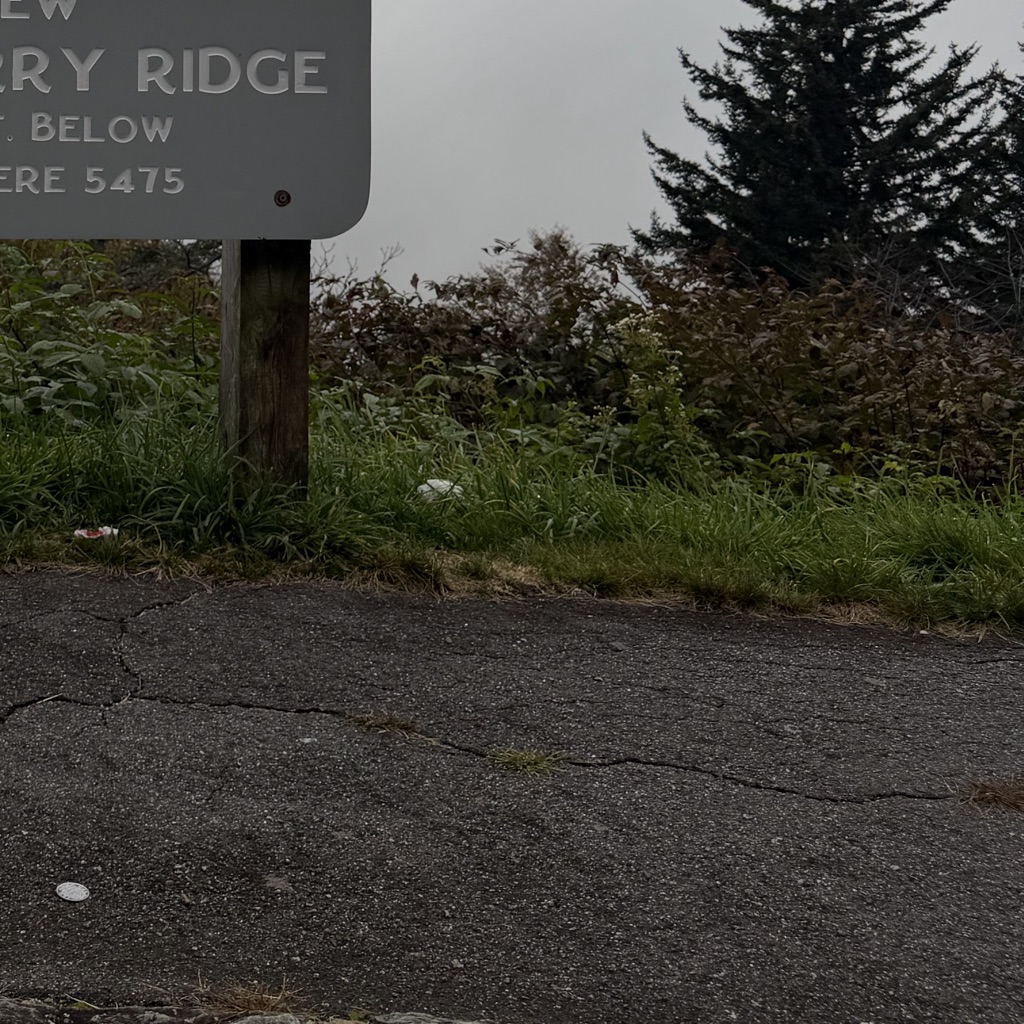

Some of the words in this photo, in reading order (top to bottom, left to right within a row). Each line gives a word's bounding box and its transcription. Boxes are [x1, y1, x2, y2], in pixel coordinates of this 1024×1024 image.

[137, 47, 328, 95] RIDGE
[31, 112, 175, 144] BELOW
[84, 166, 186, 195] 5475
